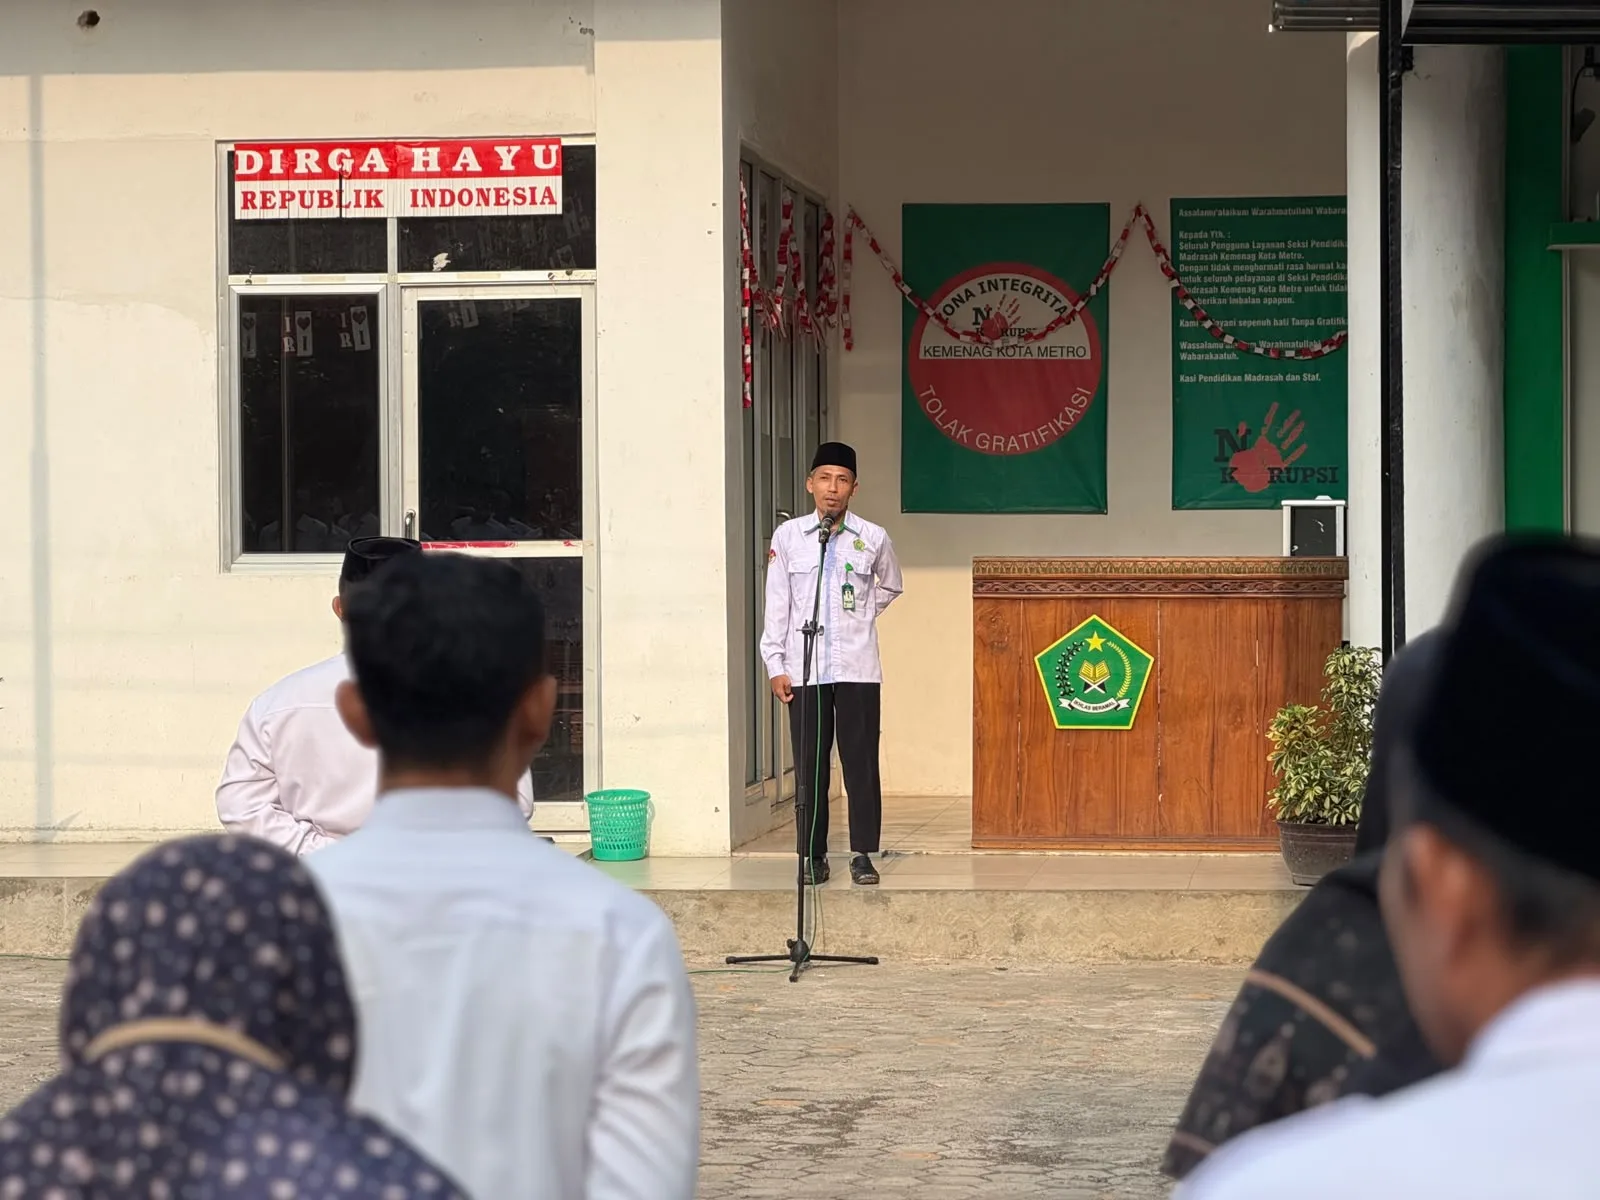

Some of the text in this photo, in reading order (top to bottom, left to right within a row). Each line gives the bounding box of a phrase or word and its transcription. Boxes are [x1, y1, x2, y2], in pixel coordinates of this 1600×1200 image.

[241, 186, 557, 210] REPUBLIK INDONESIA
[1179, 230, 1208, 240] Kepada
[1179, 239, 1347, 251] Seluruh Pengguna Layanan Seksi Pendidik
[1179, 251, 1305, 262] Madrasah Kemenag Kota Metro.
[1179, 264, 1208, 273] Dengan
[1211, 263, 1230, 272] tidak
[1232, 263, 1284, 273] menghormati
[1286, 262, 1304, 271] rasa
[1203, 274, 1233, 283] seluruh
[1235, 274, 1275, 284] pelayanan
[1278, 273, 1286, 282] di
[1287, 273, 1309, 282] Seksi
[1311, 272, 1347, 282] Pendidik
[1187, 286, 1219, 294] adrasah
[1220, 285, 1256, 295] Kemenag
[1258, 285, 1277, 294] Kota
[1279, 285, 1303, 293] Metro
[1304, 284, 1327, 293] untuk
[942, 287, 976, 323] ONA
[1229, 296, 1261, 305] imbalan
[1263, 296, 1295, 306] apapun.
[1179, 319, 1199, 328] Kami
[1238, 318, 1271, 328] sepenuh
[1273, 317, 1289, 327] hati
[1291, 317, 1315, 327] Tanpa
[1317, 317, 1347, 326] Gratifik
[923, 345, 1087, 358] KEMENAG KOTA METRO
[1180, 372, 1322, 382] Kasi Pendidikan Madrasah dan Staf.
[920, 385, 1092, 452] TOLAK GRATIFIKASI
